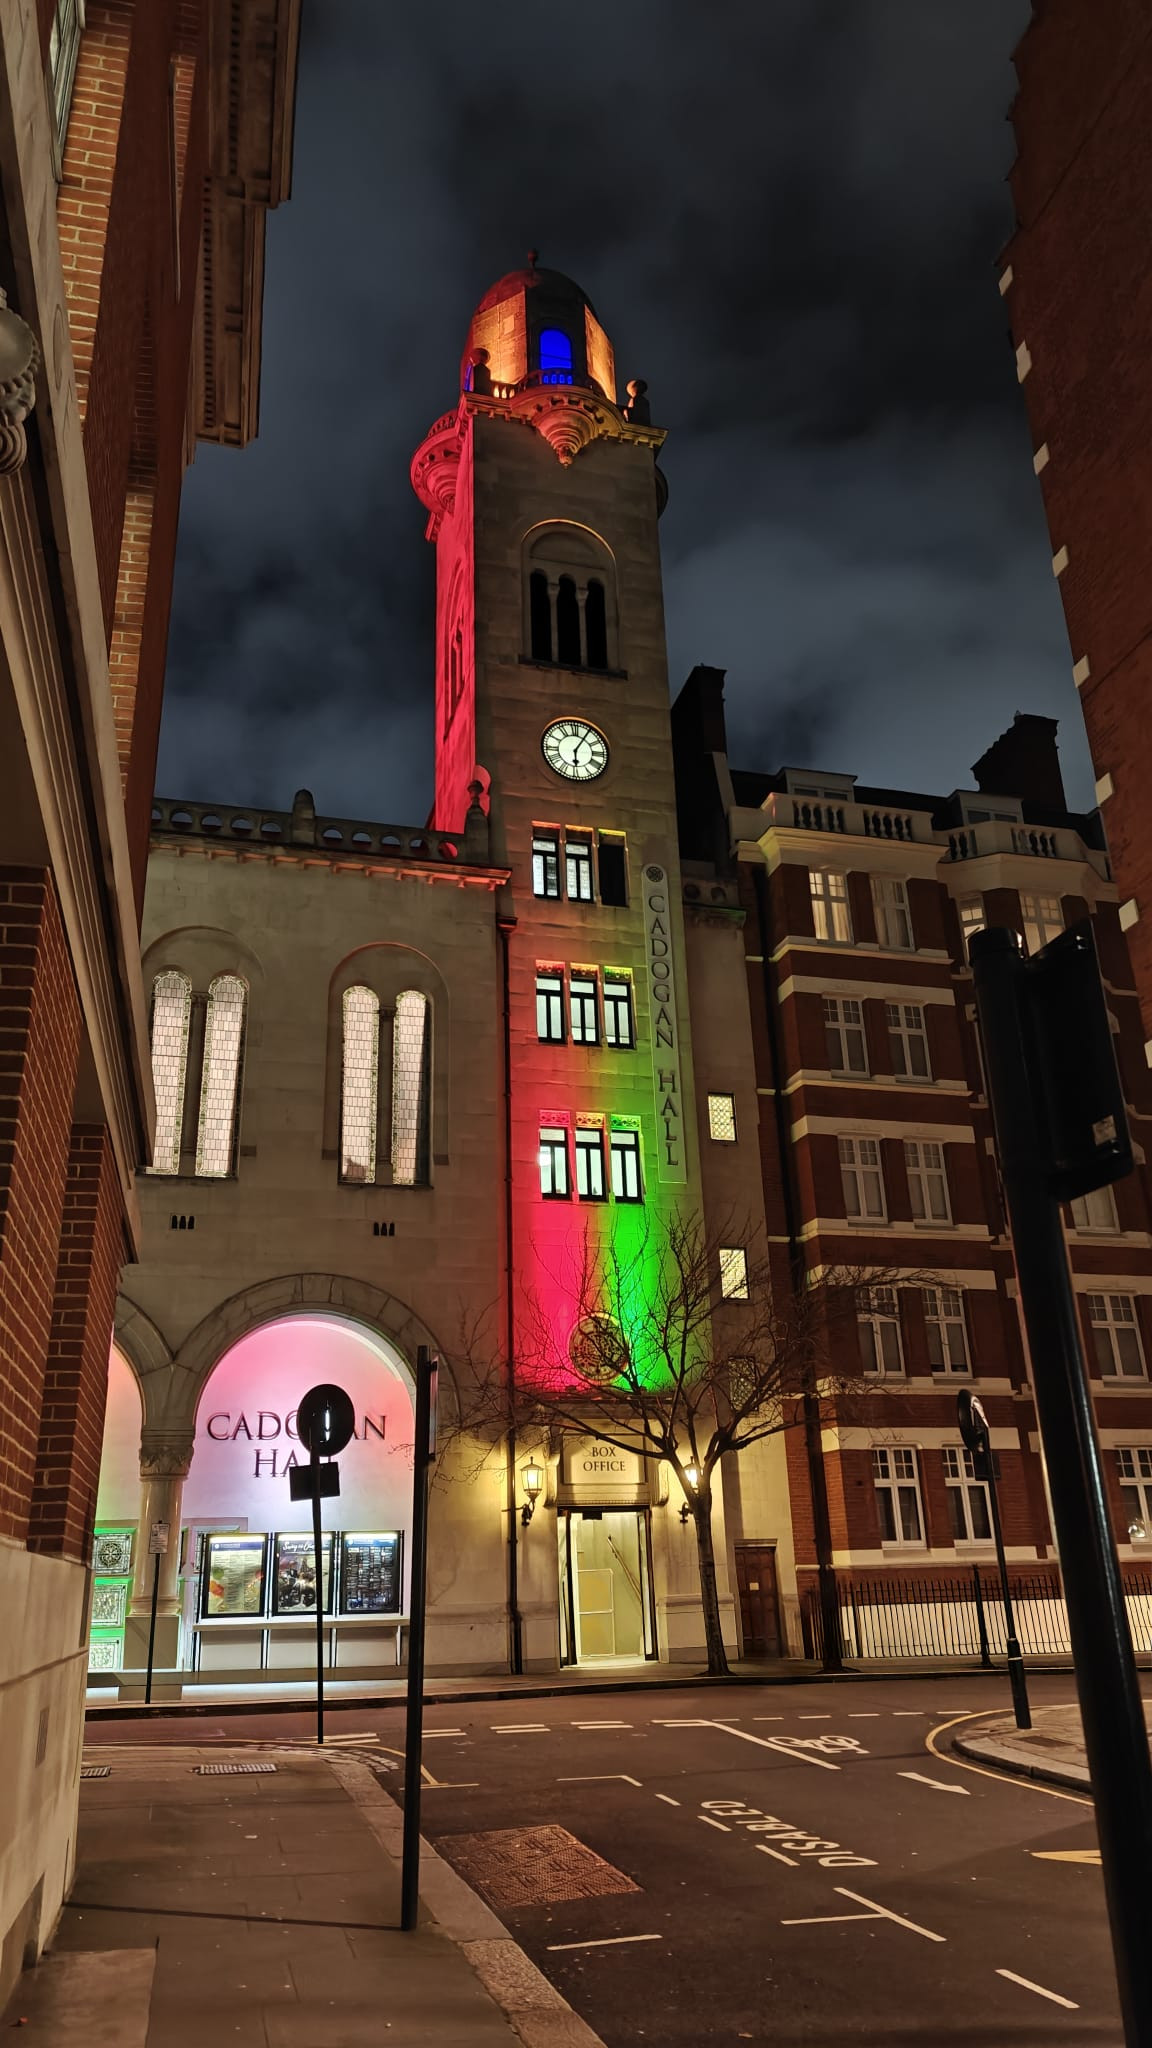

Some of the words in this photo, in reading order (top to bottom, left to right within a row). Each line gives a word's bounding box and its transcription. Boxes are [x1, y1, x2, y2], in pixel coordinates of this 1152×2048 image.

[648, 895, 674, 1049] CADOGAN
[657, 1068, 680, 1166] HALL
[583, 1460, 626, 1472] OFFICE
[591, 1446, 617, 1457] BOX
[700, 1800, 879, 1867] DISABLED
